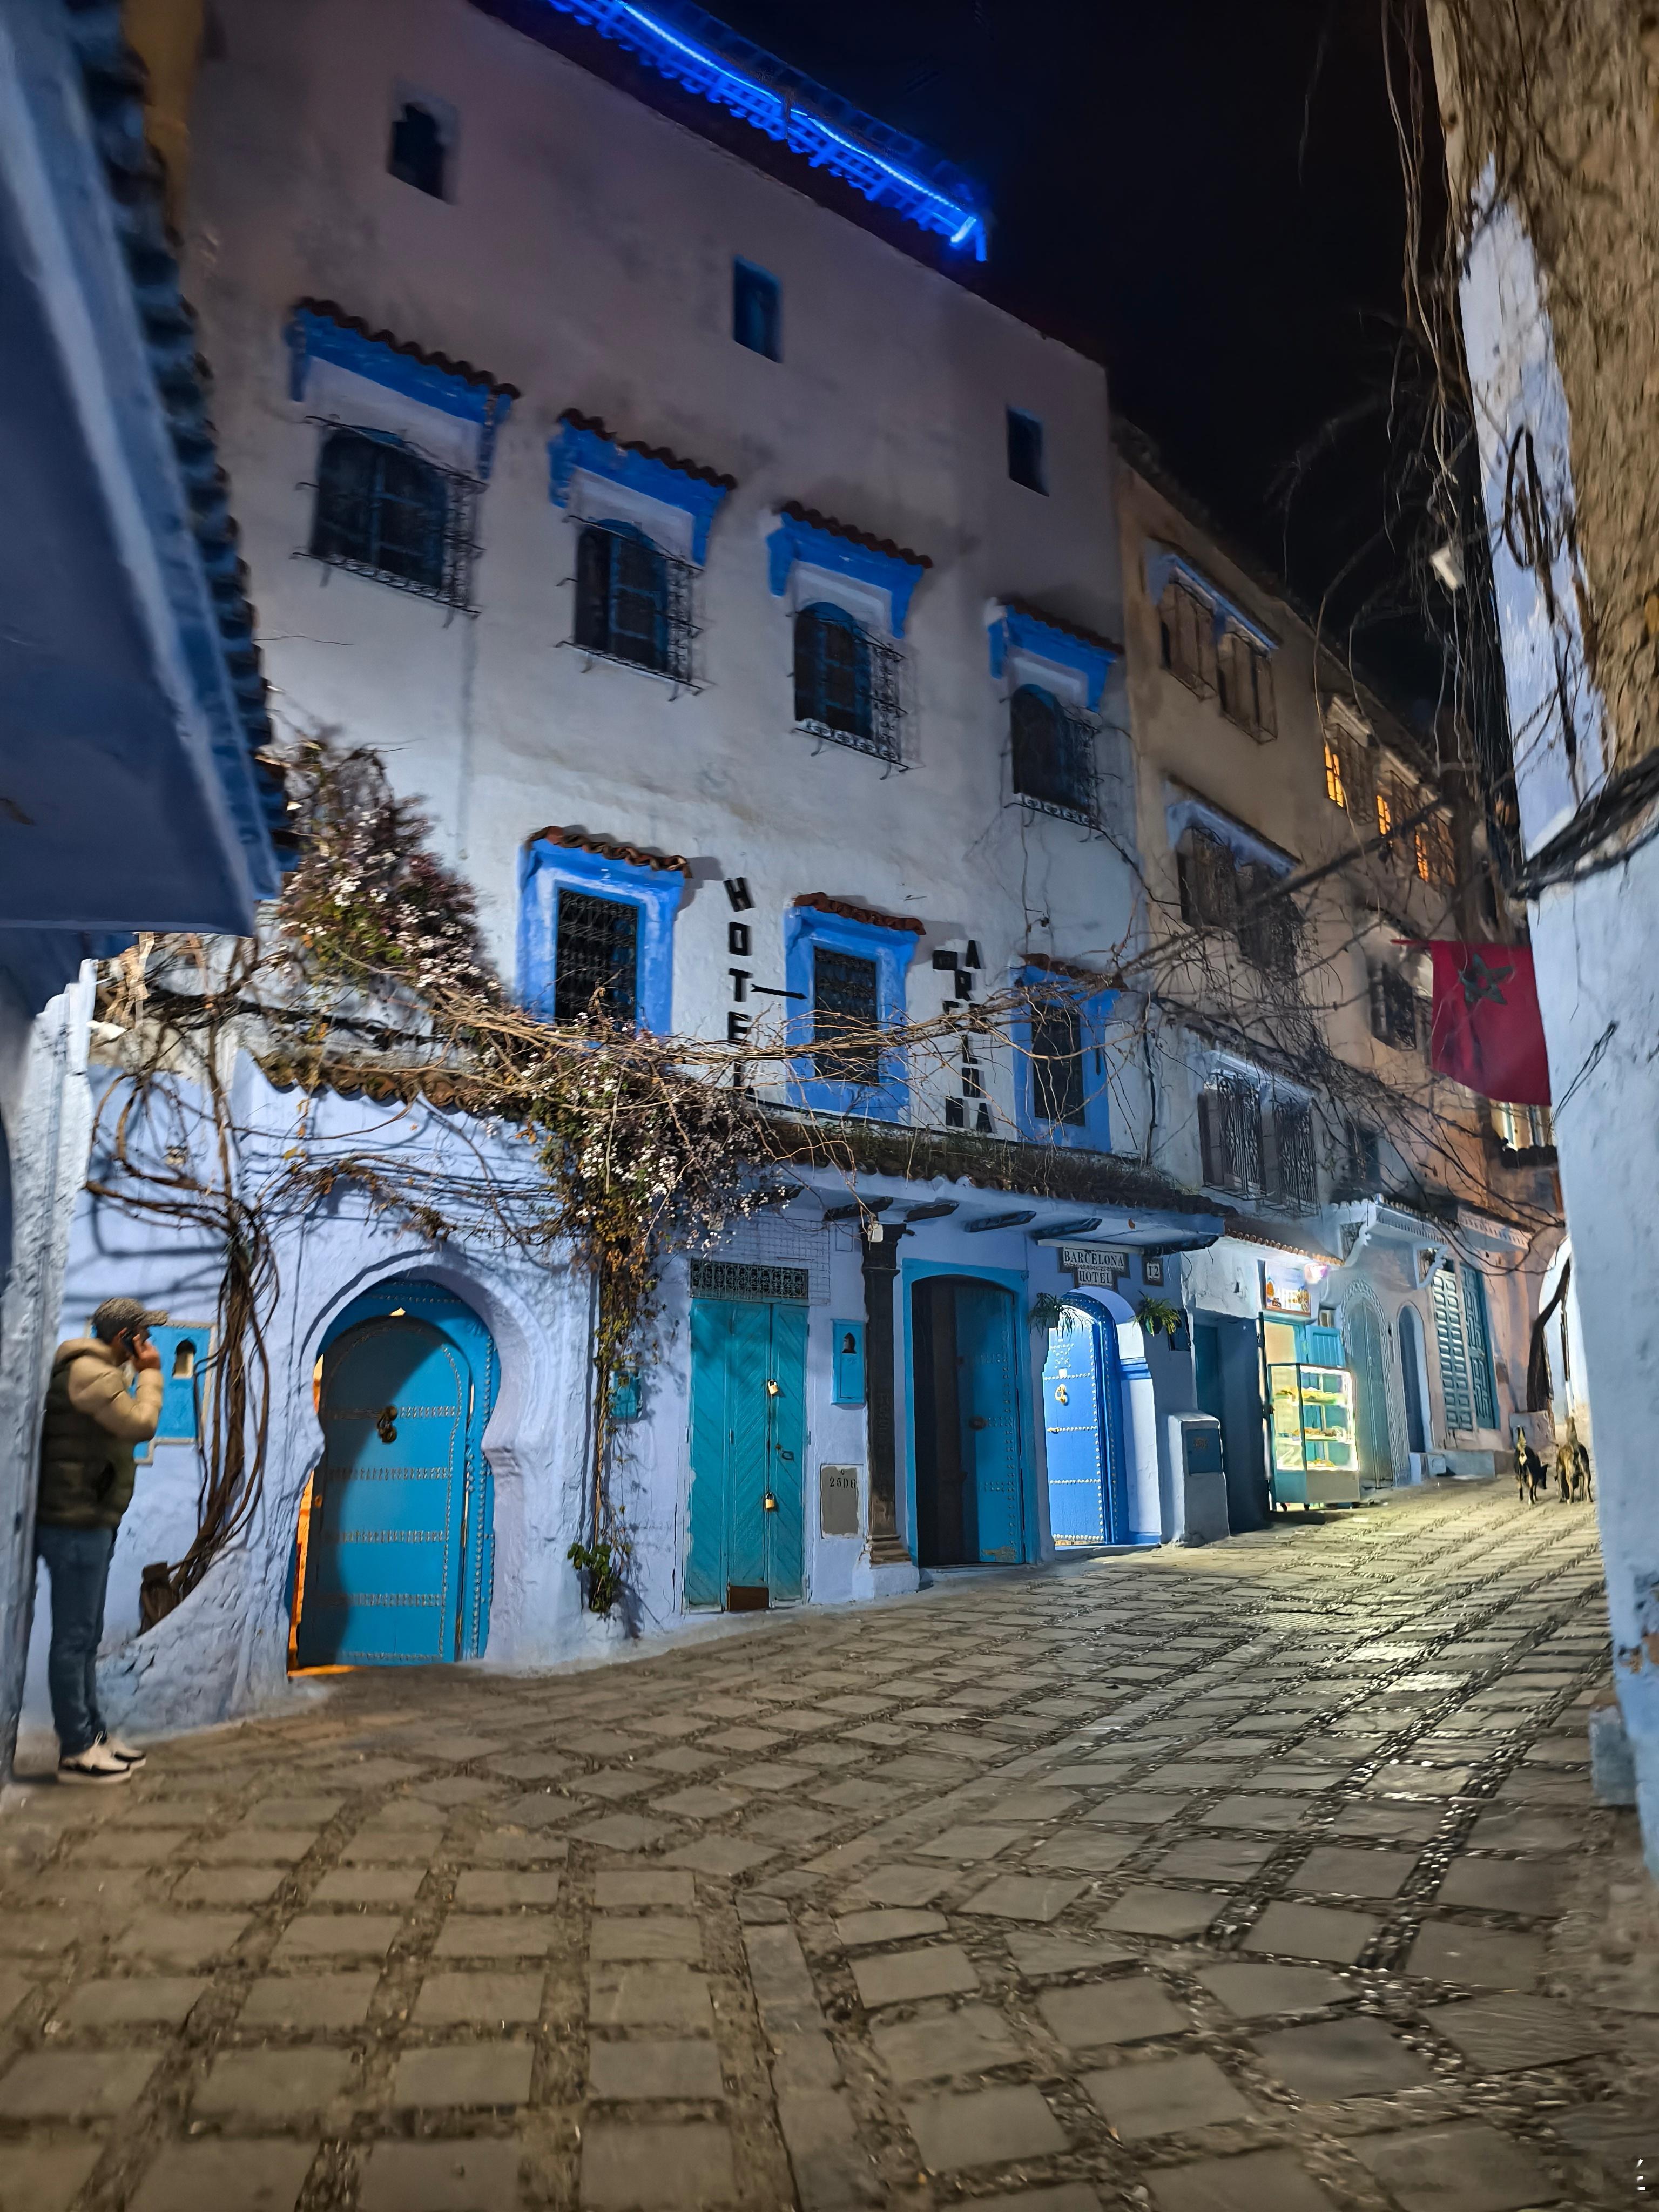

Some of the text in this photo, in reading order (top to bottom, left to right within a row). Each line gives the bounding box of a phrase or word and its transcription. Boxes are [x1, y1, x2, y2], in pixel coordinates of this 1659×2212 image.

[724, 877, 753, 1095] HOTEL
[1064, 1250, 1124, 1266] BARCELONA
[1079, 1270, 1112, 1284] HOTEL
[1148, 1265, 1159, 1276] 12
